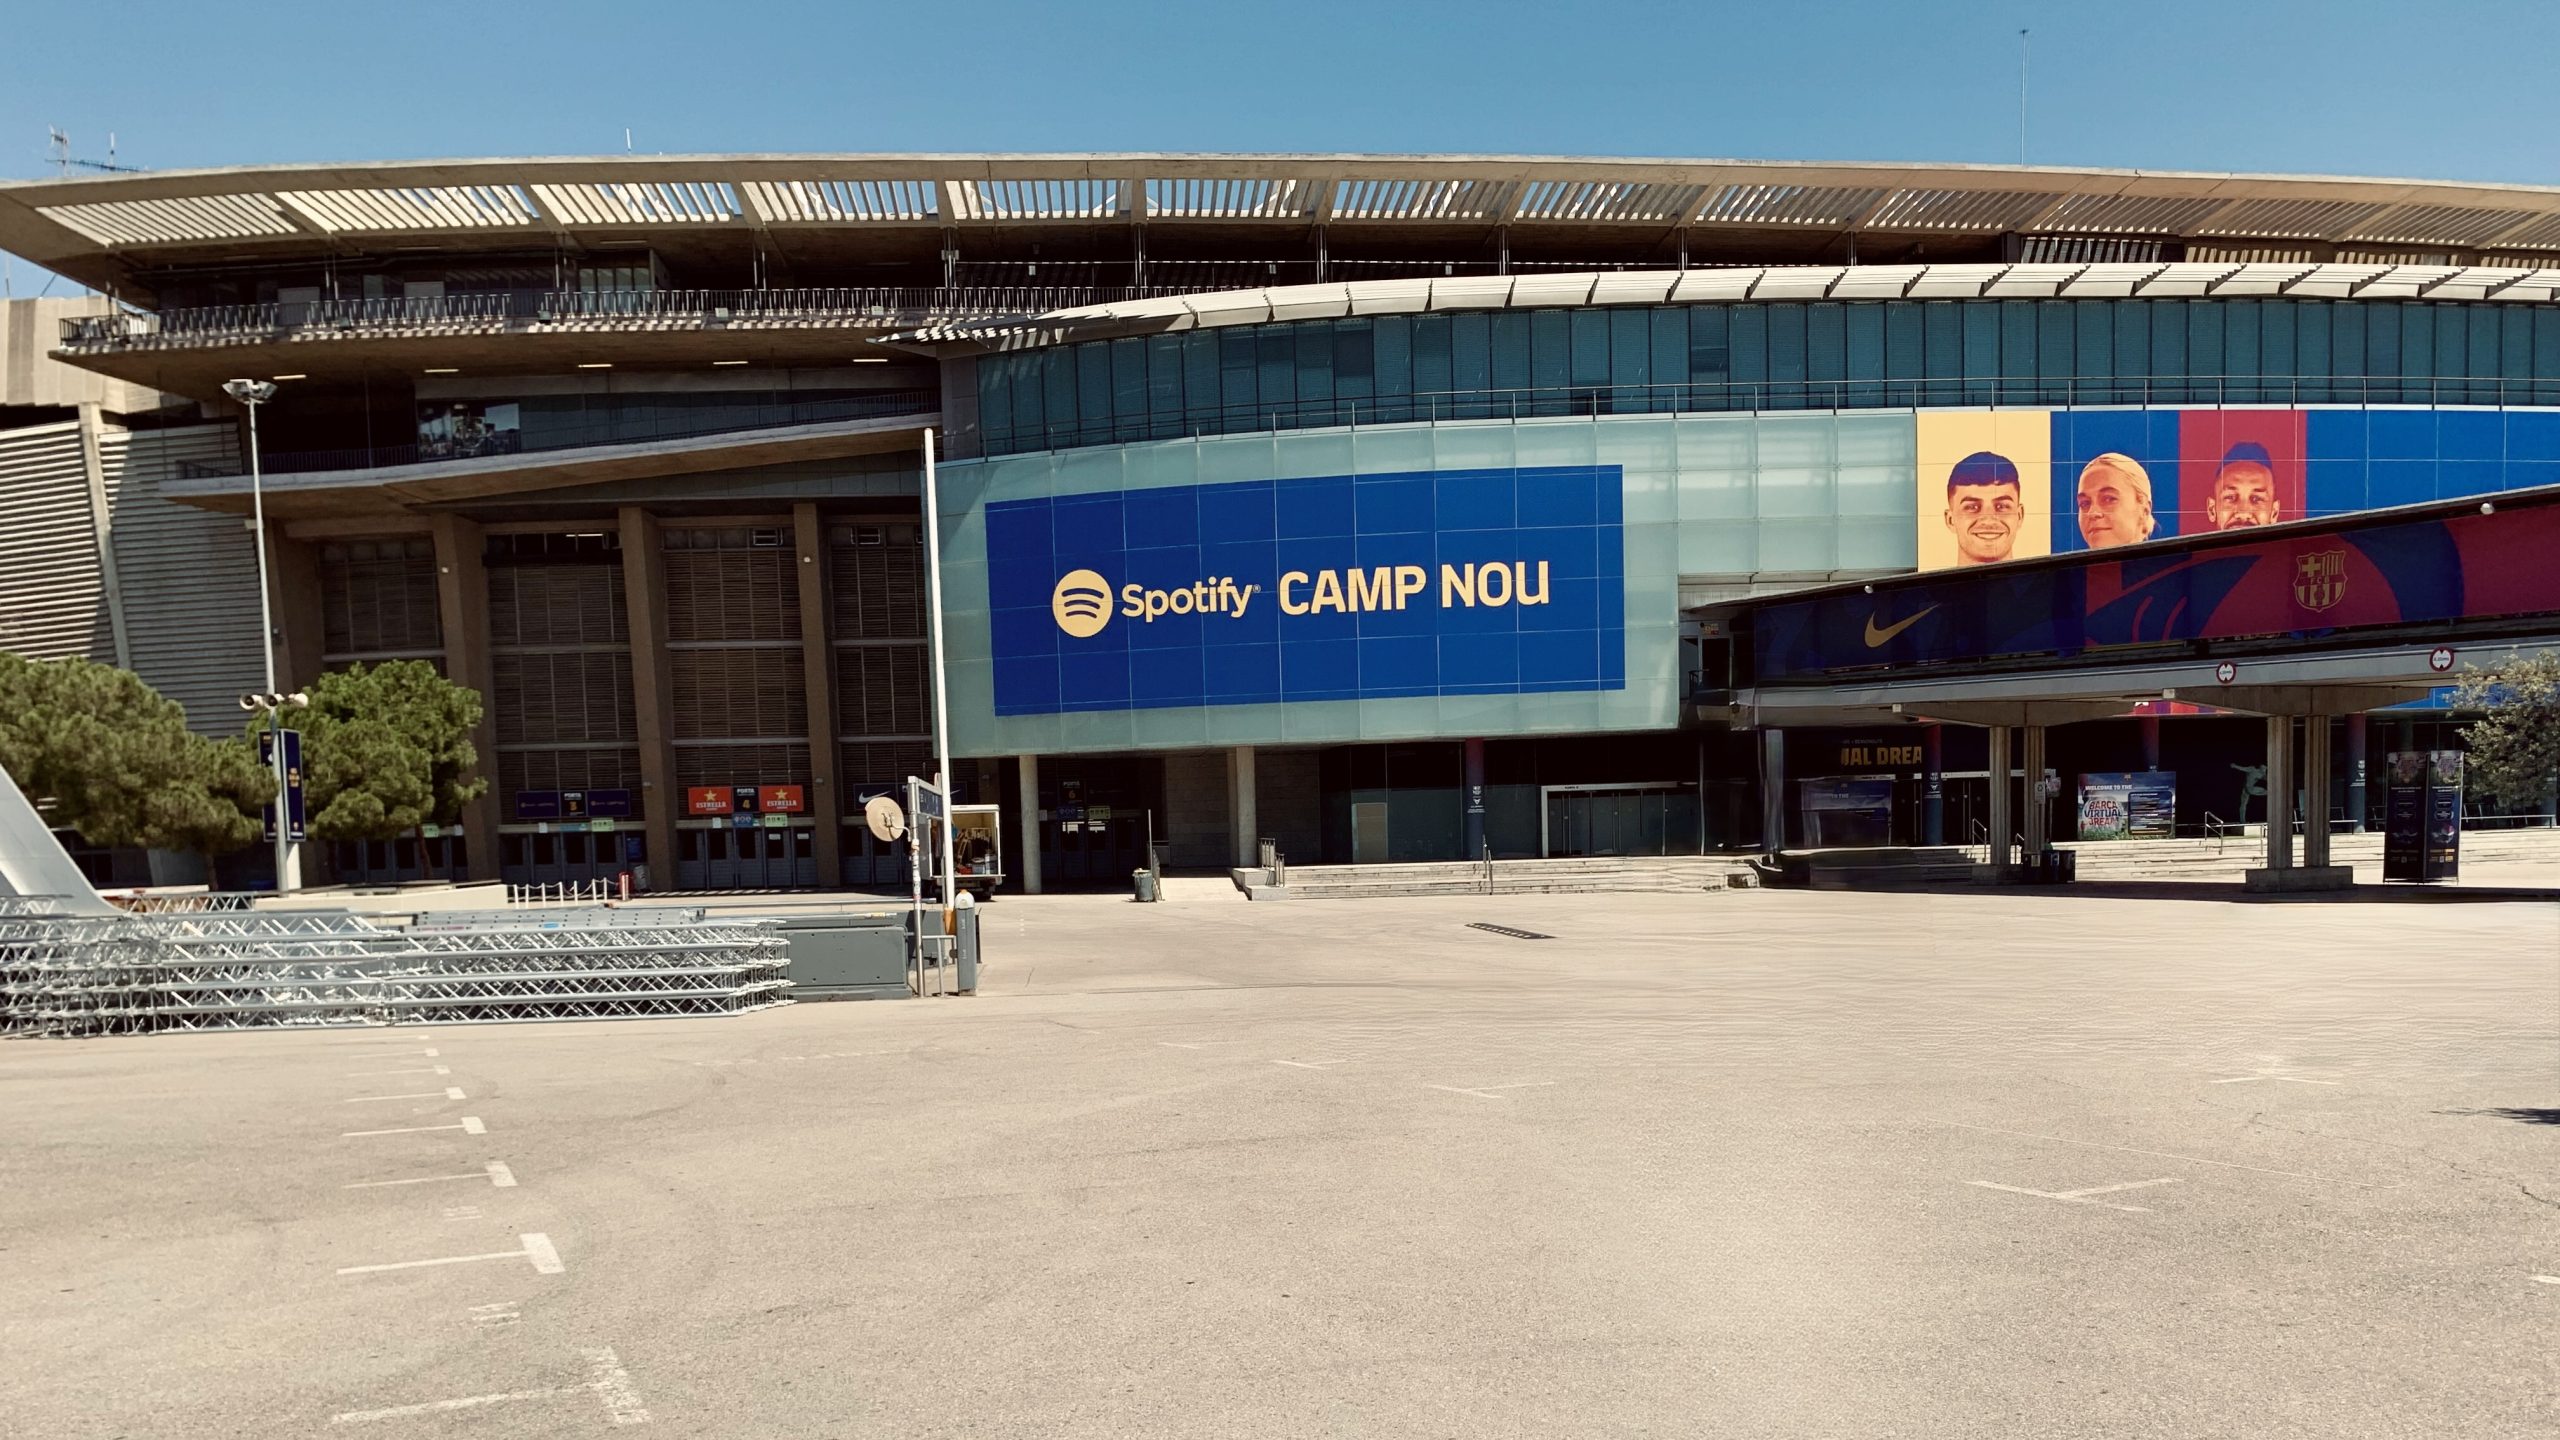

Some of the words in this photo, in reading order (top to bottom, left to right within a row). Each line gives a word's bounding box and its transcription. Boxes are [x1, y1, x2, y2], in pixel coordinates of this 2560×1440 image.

[1279, 565, 1427, 616] CAMP
[1441, 560, 1549, 608] NOU
[696, 801, 727, 809] ESTRELLA
[742, 799, 751, 809] 4
[2084, 809, 2122, 818] VIRTUAL
